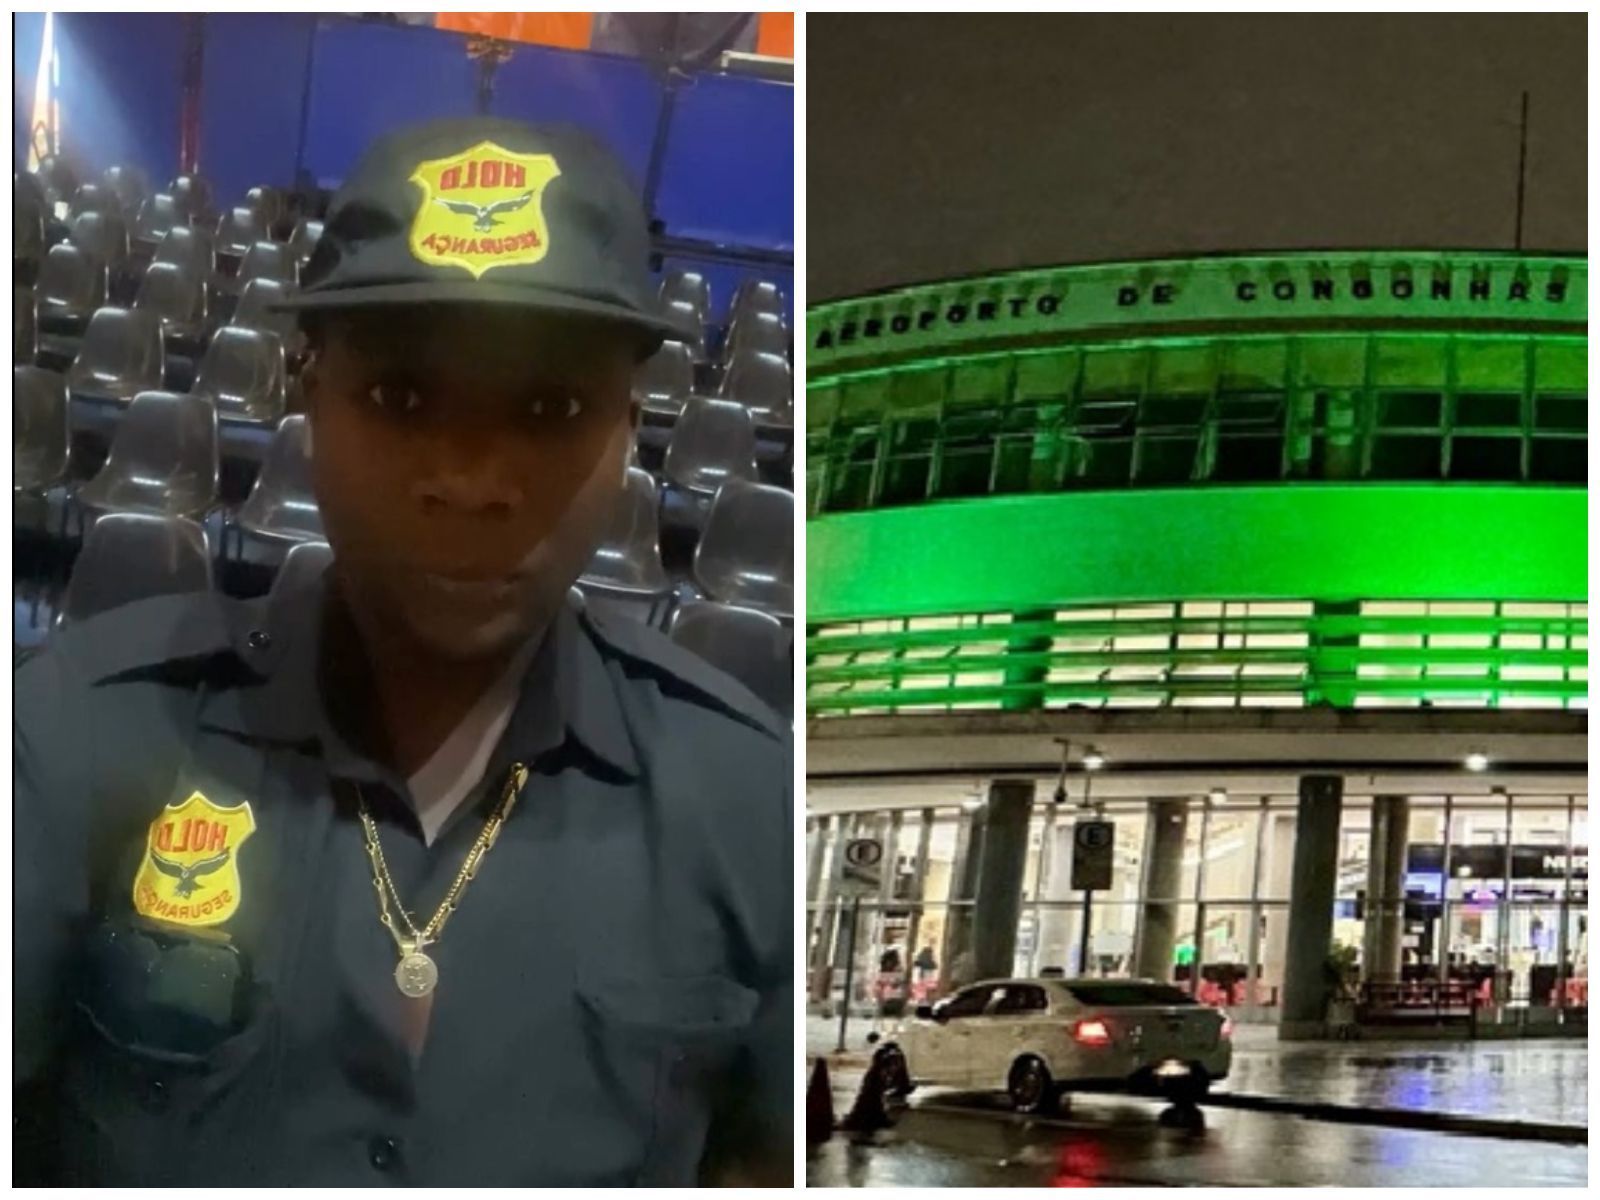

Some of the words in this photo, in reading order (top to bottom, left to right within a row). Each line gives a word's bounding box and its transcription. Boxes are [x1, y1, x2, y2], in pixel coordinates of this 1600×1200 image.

[815, 294, 1060, 348] AEROPORTO
[1116, 283, 1175, 307] DE
[1236, 277, 1566, 304] CONGONHAS
